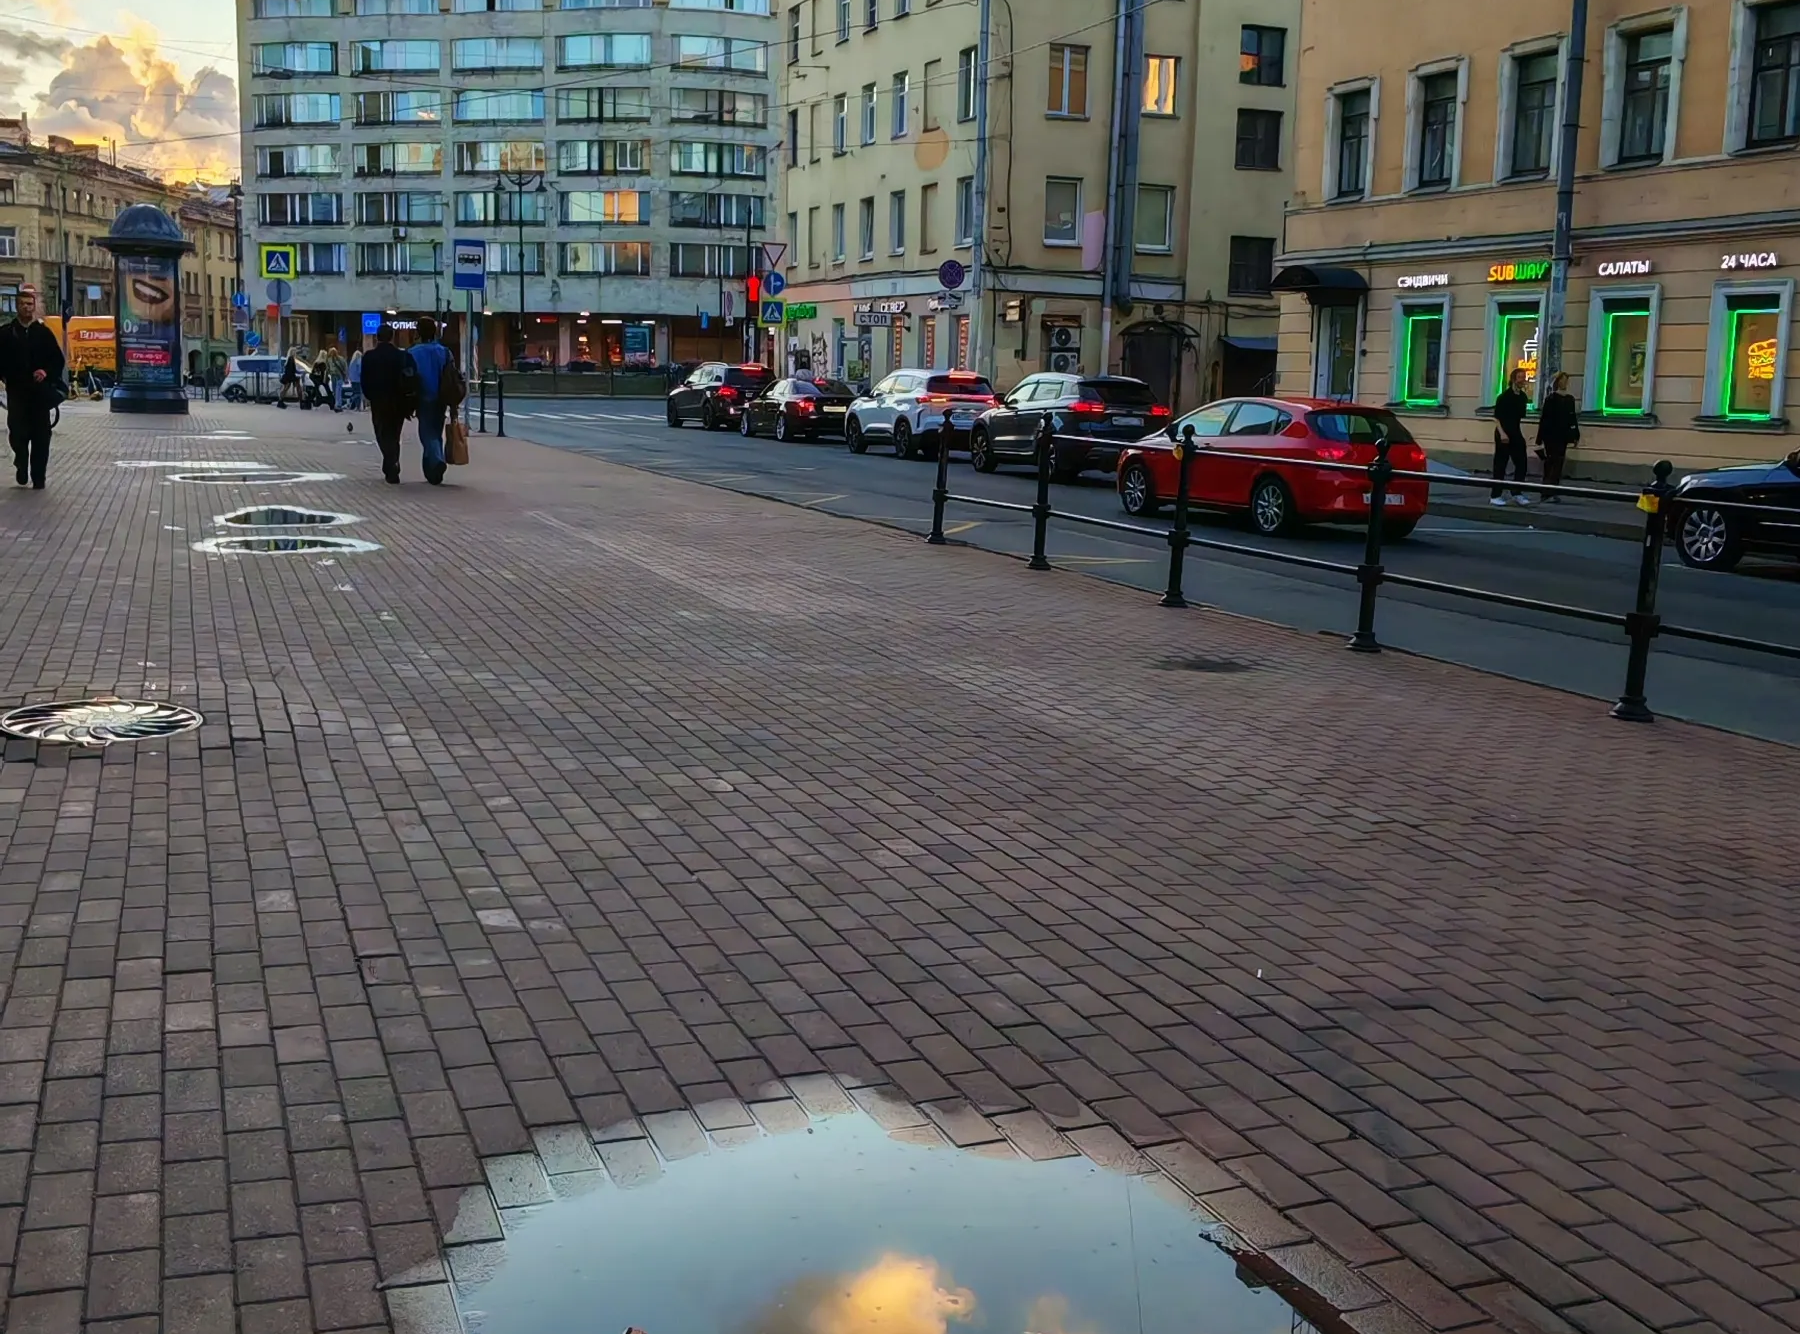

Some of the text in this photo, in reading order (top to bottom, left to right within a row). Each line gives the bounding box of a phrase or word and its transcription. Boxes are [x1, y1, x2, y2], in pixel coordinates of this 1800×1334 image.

[1598, 260, 1650, 276] САЛАТЫ
[1720, 252, 1777, 269] 24 ЧАСА
[1487, 261, 1549, 282] SUBWAY
[1397, 273, 1449, 288] СЭНДВИЧИ
[860, 314, 887, 324] СТОП
